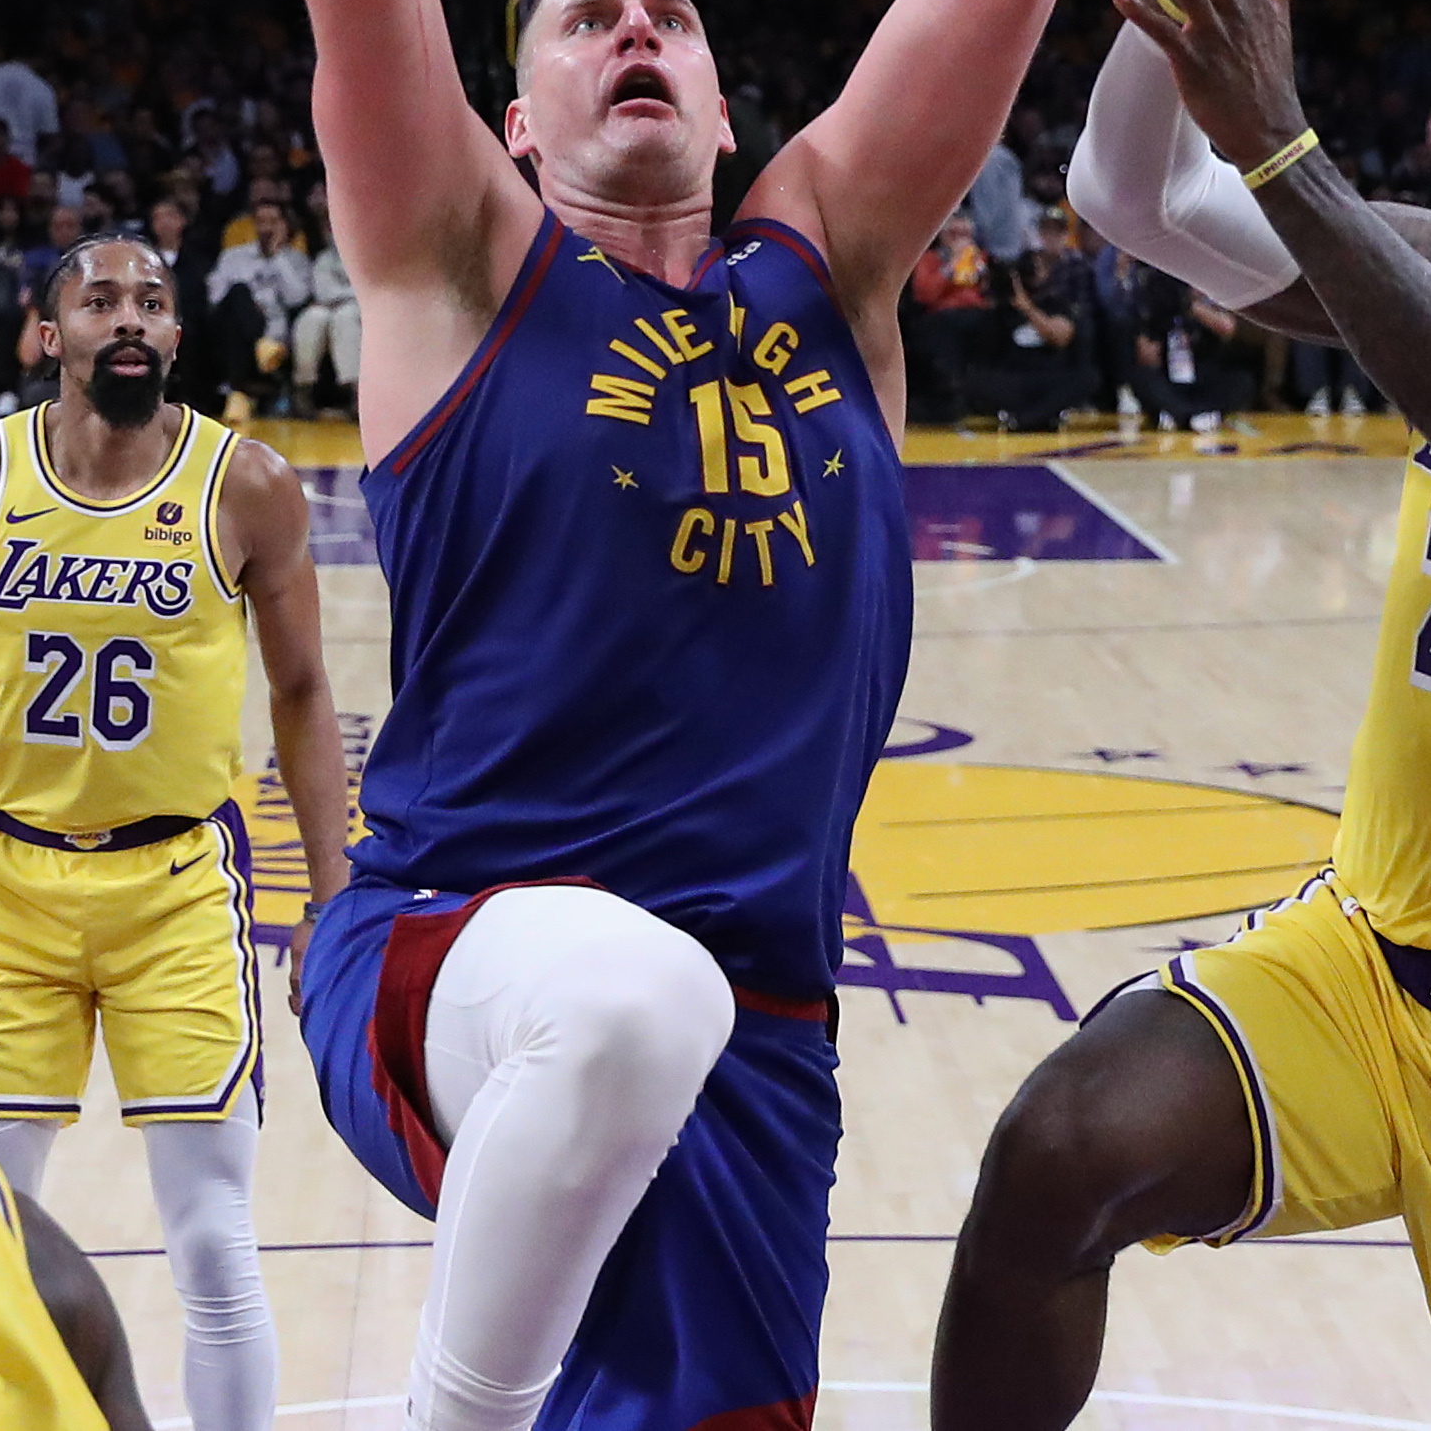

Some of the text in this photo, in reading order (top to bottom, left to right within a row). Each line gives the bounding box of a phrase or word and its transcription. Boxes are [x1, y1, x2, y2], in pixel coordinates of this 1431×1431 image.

[689, 376, 792, 497] 15
[144, 526, 193, 546] bibigo
[670, 500, 817, 587] CITY
[22, 630, 158, 753] 26
